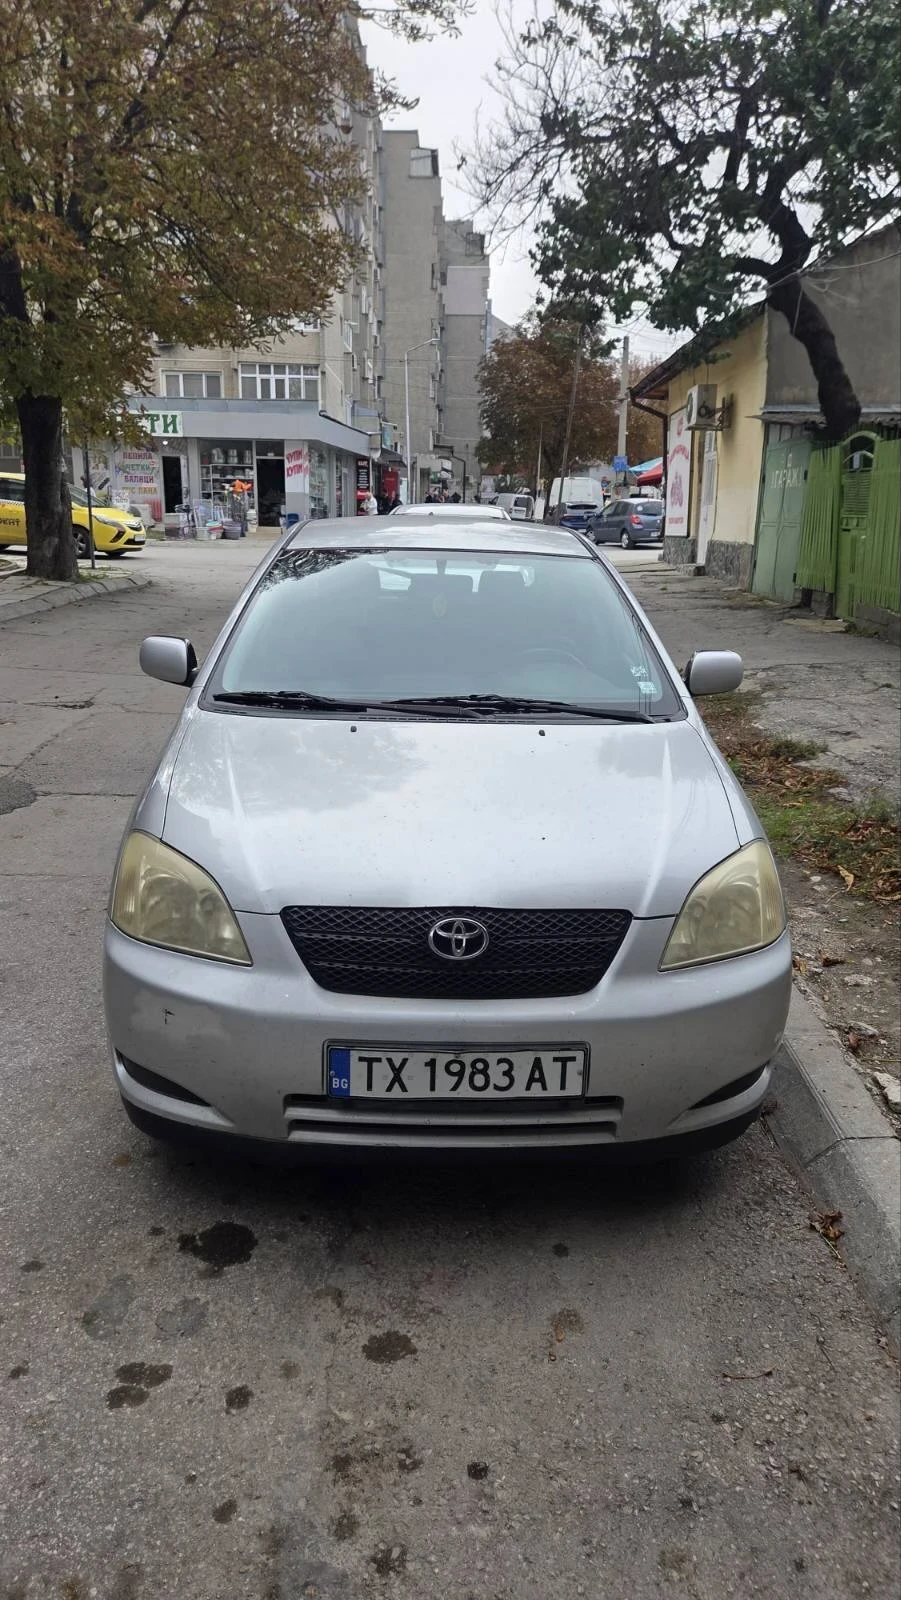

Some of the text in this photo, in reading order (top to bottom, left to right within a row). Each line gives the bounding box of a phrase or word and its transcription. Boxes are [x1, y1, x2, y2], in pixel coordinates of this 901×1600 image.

[332, 1077, 348, 1089] BG
[358, 1056, 577, 1093] TX 1983 AT
